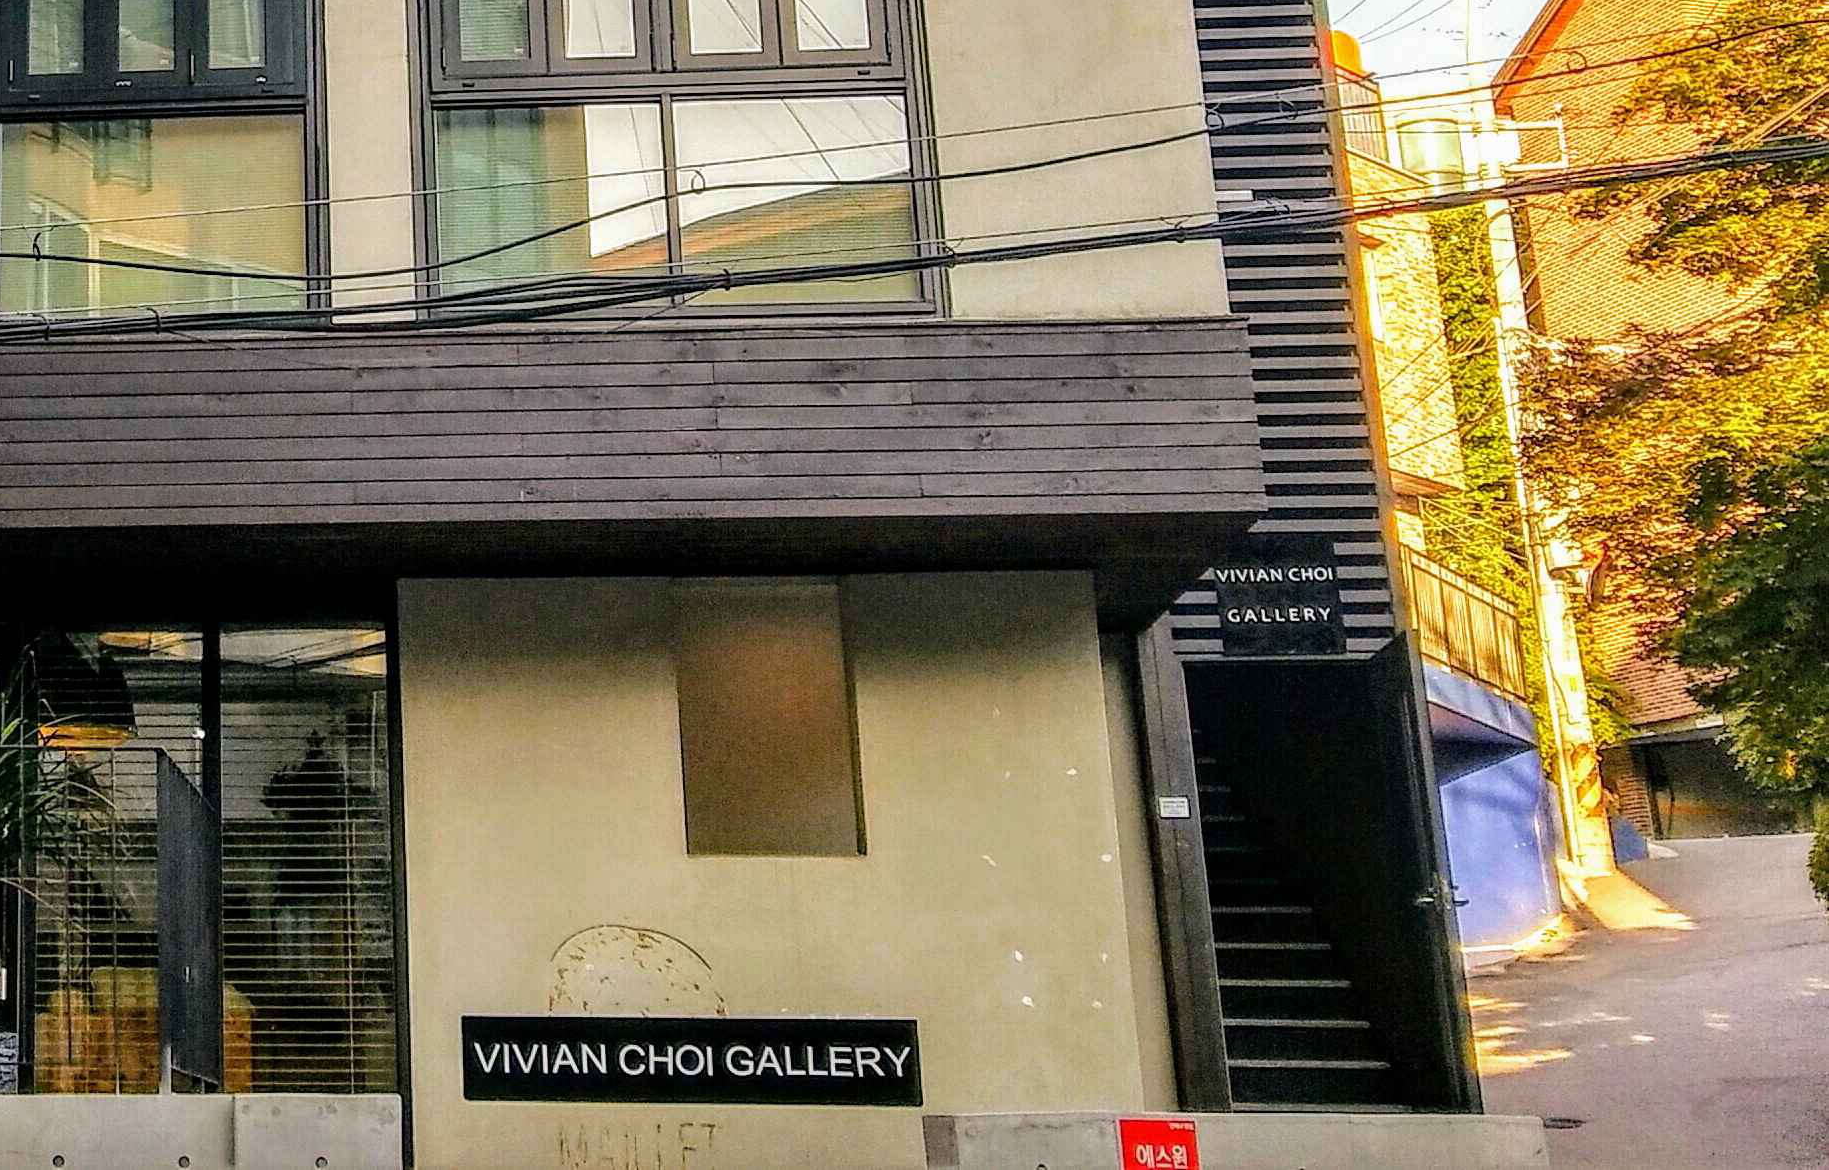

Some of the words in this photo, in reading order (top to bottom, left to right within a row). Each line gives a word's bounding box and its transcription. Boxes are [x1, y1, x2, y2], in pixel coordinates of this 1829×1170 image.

[1216, 567, 1283, 583] VIVIAN
[1288, 566, 1334, 581] CHOI
[1226, 606, 1331, 623] GALLERY
[473, 1042, 608, 1074] VIVIAN
[617, 1043, 714, 1077] CHOI
[724, 1045, 912, 1079] GALLERY
[1135, 1144, 1189, 1170] 에스원
